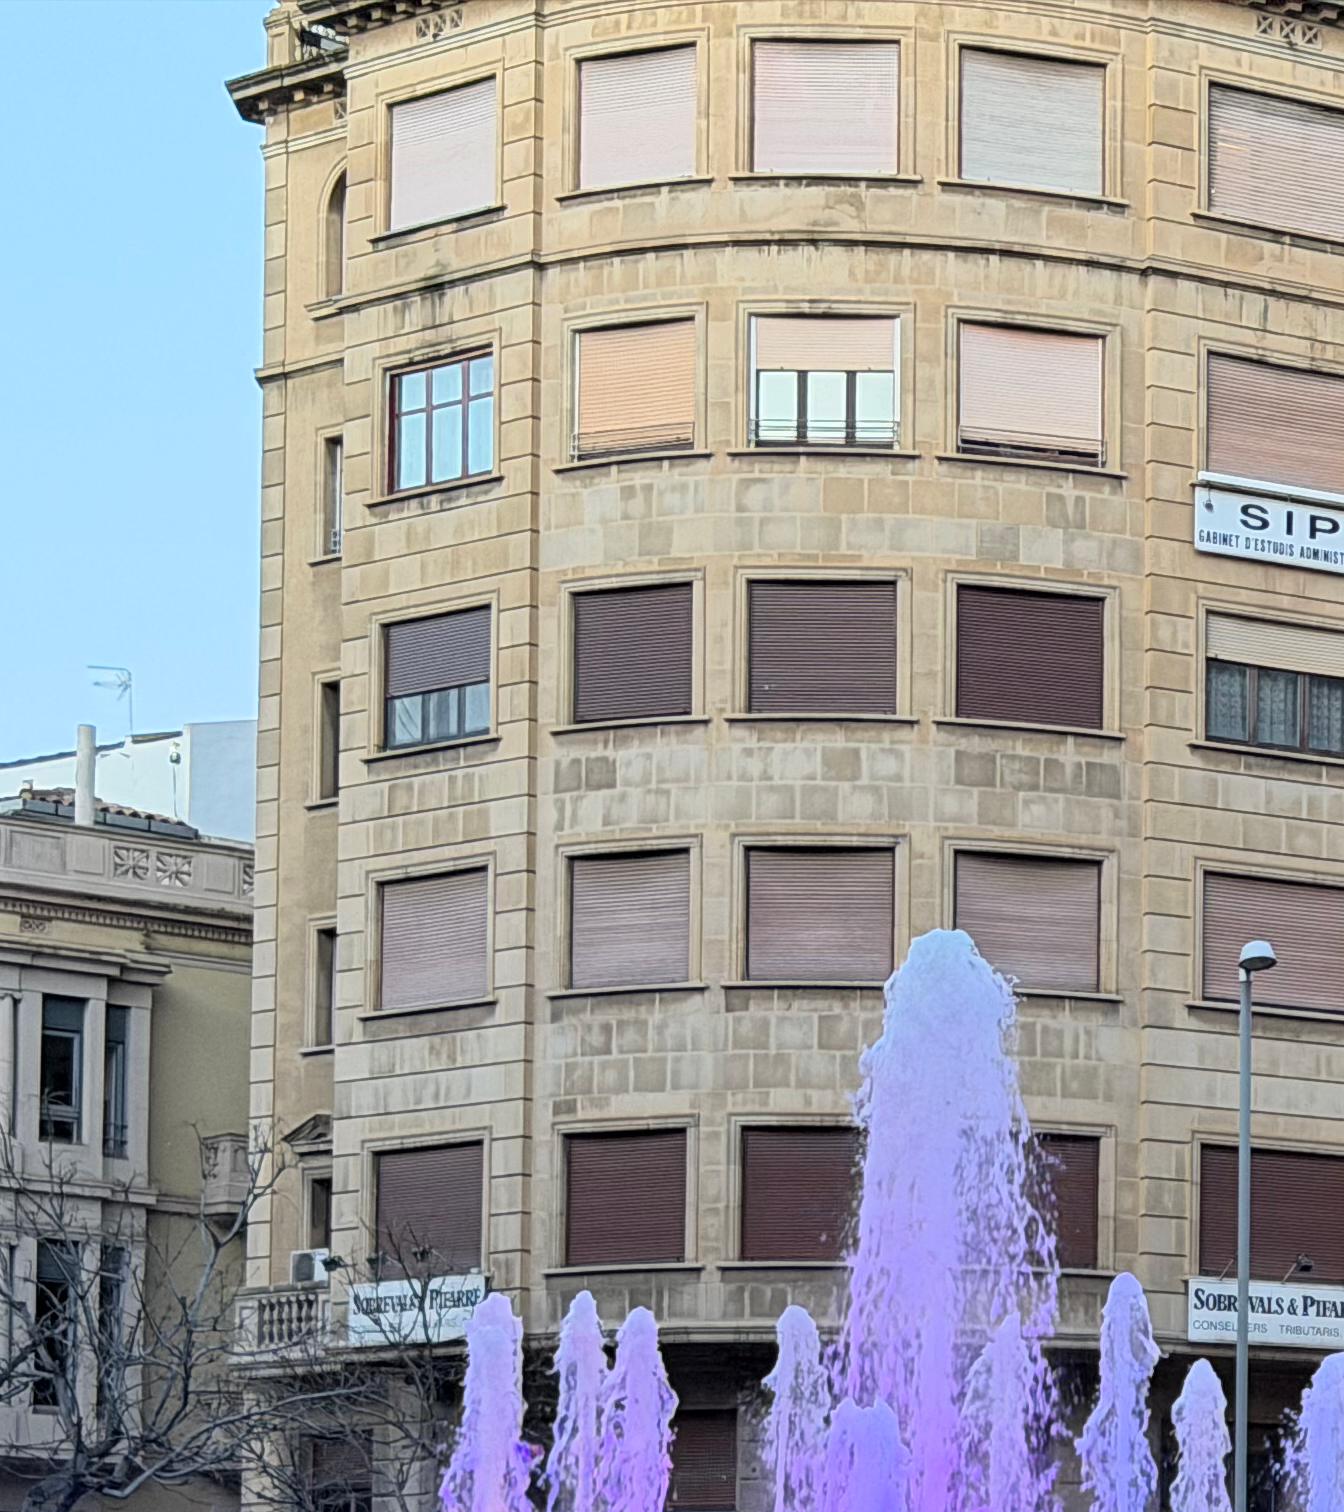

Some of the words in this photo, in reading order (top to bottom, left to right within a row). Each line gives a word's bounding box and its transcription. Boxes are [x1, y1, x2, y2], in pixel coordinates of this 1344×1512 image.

[1240, 503, 1340, 539] SIP
[1198, 528, 1241, 549] GABINET
[1244, 536, 1295, 558] D'ESTUDIS
[1193, 1287, 1285, 1316] SOBRVALS
[1287, 1298, 1299, 1317] &
[1192, 1319, 1268, 1334] CONSELERS
